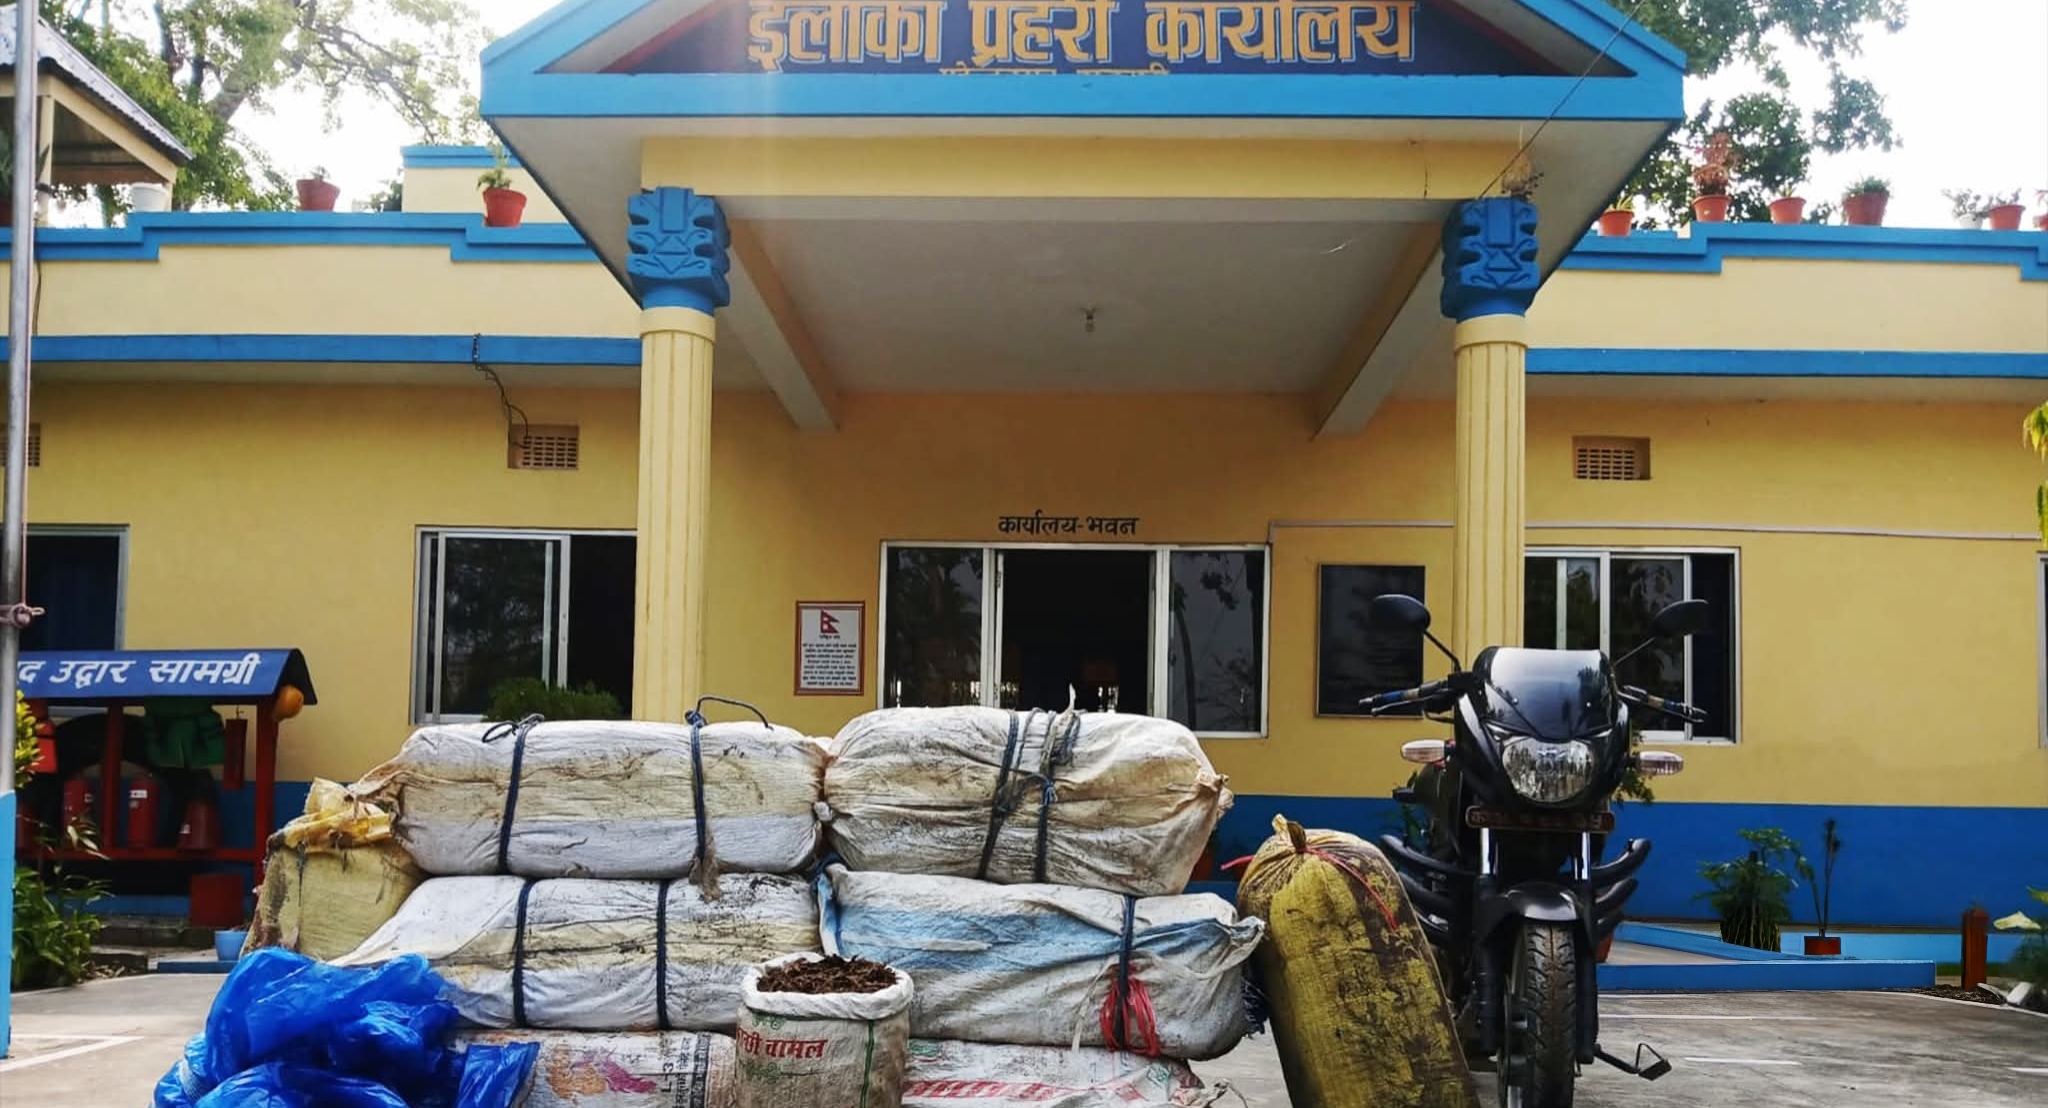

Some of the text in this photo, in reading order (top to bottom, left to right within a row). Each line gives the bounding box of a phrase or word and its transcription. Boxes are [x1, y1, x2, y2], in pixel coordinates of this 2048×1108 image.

[748, 0, 947, 73] इलाका
[149, 653, 261, 685] सामग्री
[766, 1039, 828, 1058] चामल
